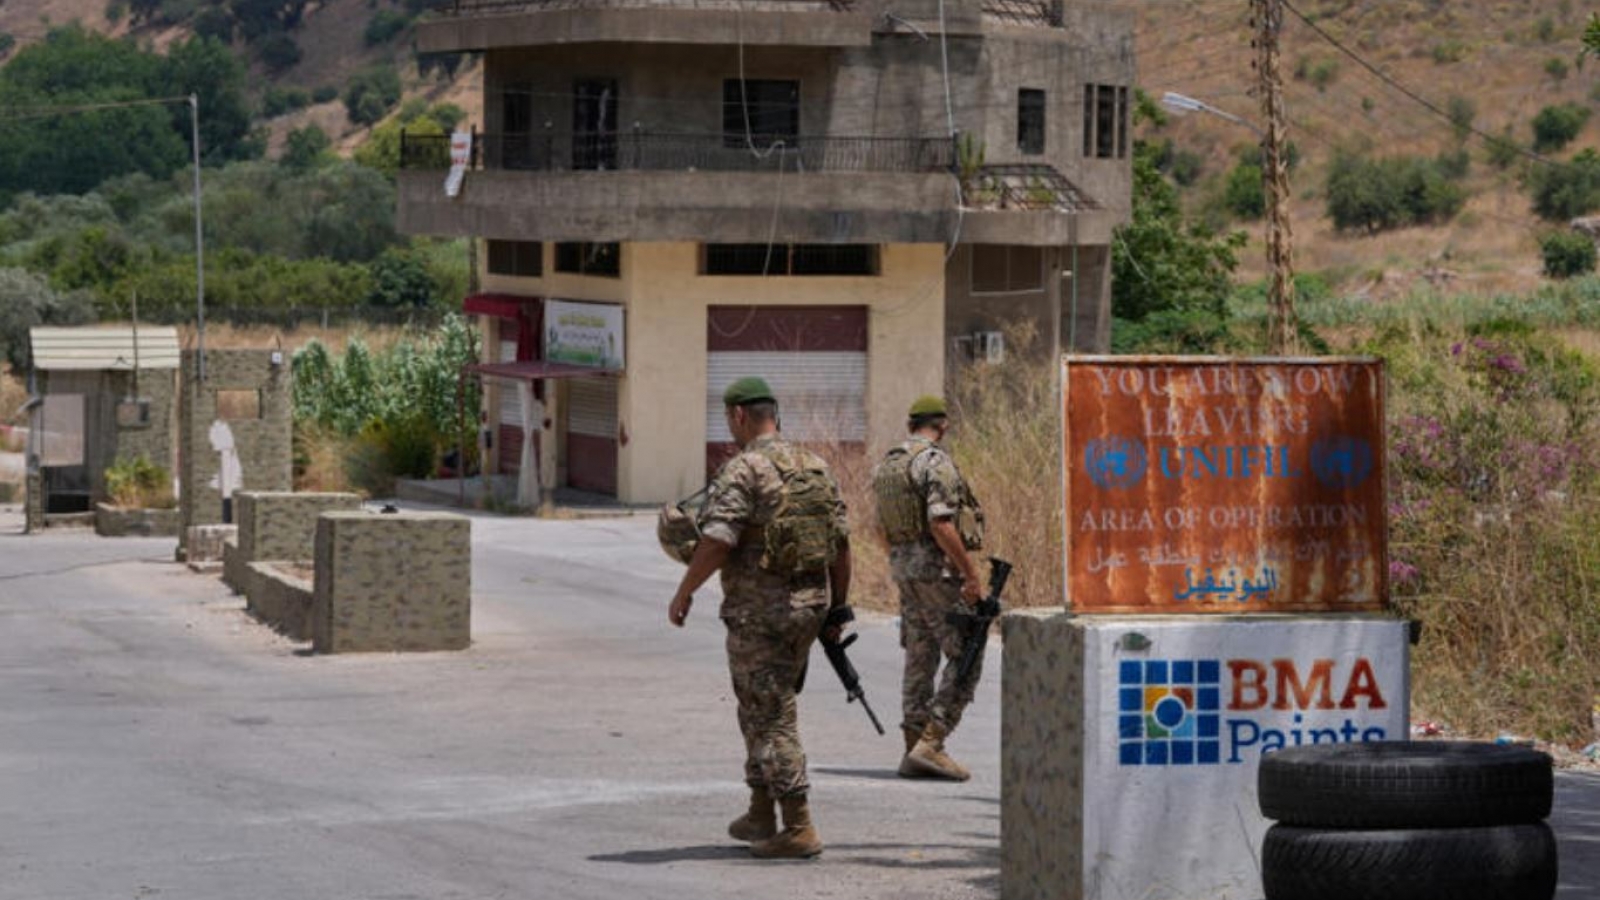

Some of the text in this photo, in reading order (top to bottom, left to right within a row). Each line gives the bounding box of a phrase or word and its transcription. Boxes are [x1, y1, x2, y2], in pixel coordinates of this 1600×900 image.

[1095, 366, 1357, 396] YOU ARE NOW
[1143, 404, 1310, 437] LEAVING
[1159, 444, 1303, 479] UNIFIL
[1080, 503, 1367, 532] AREA OF OPERATION
[1173, 564, 1277, 602] اليونيفيل
[1226, 658, 1387, 711] BMA
